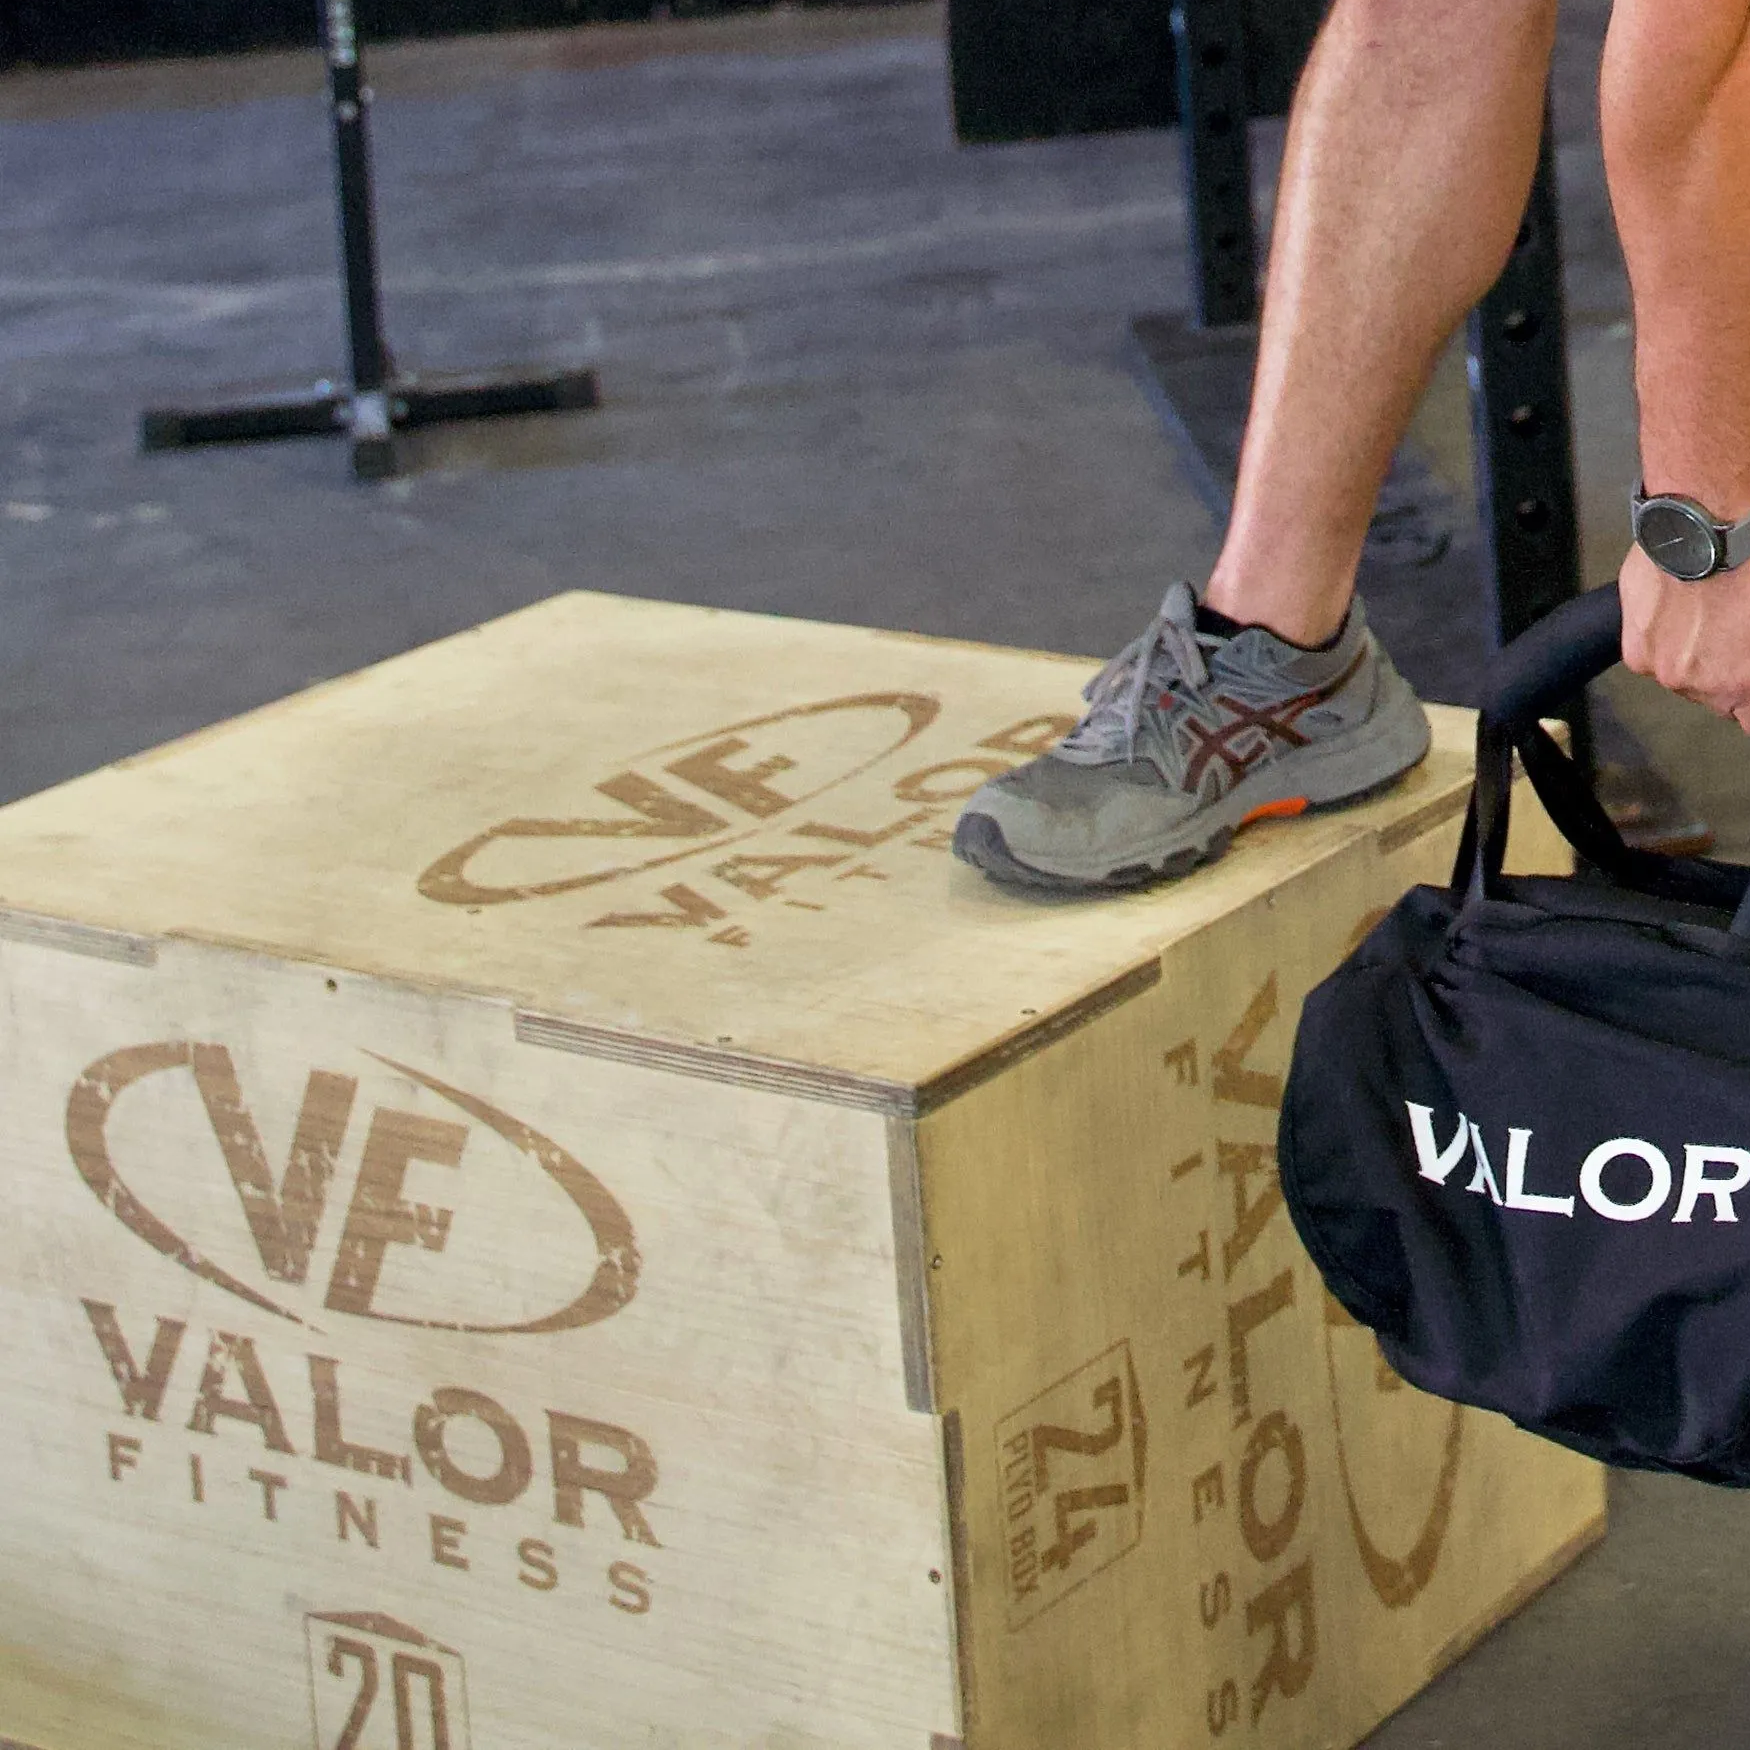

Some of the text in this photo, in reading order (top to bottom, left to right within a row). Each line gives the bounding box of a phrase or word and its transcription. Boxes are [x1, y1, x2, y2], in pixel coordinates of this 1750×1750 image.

[80, 1297, 663, 1549] VALOR
[1163, 1037, 1240, 1738] FITNESS
[1210, 970, 1318, 1729] VALOR
[106, 1431, 653, 1615] FITNESS
[1008, 1524, 1041, 1604] BOX
[1031, 1375, 1129, 1574] 24
